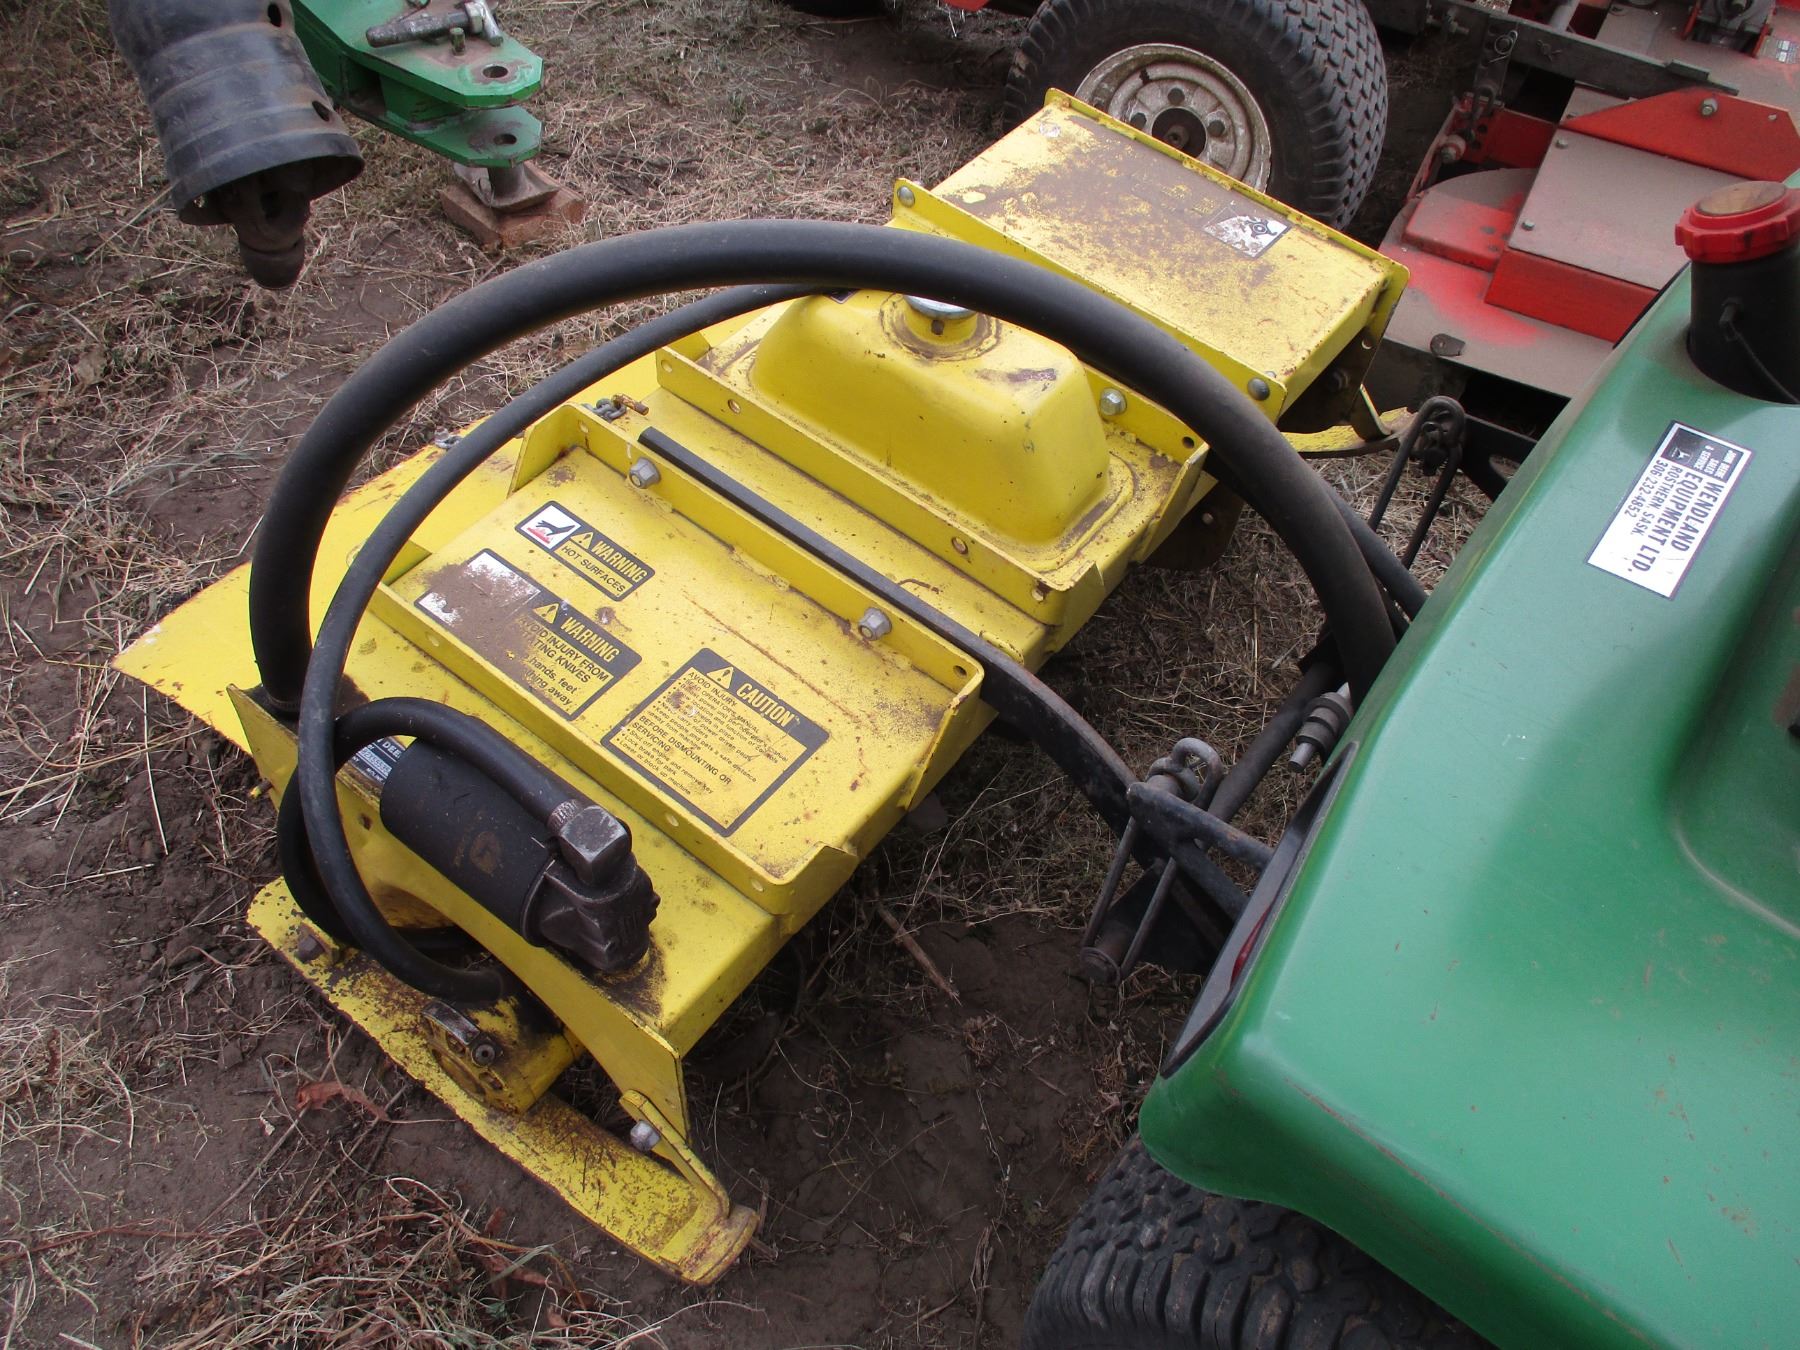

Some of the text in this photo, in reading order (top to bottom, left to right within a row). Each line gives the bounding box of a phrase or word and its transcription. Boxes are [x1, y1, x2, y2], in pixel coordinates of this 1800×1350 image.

[1628, 472, 1703, 574] EQUIPMENT LTD.
[1671, 482, 1724, 551] WENDLAND
[561, 545, 626, 592] HOT SURFACES
[591, 540, 647, 582] WARNING
[546, 635, 581, 661] INJURY
[579, 659, 609, 682] FROM
[560, 616, 620, 662] WARNING
[528, 656, 577, 694] hands, feet
[555, 655, 591, 683] KNIVES
[688, 672, 737, 707] AVOID INJURY
[548, 686, 572, 706] away
[736, 683, 795, 727] CAUTION
[632, 722, 671, 752] SERVICING
[735, 715, 759, 733] MANUAL
[639, 715, 732, 785] BEFORE DISMOUNTING OR
